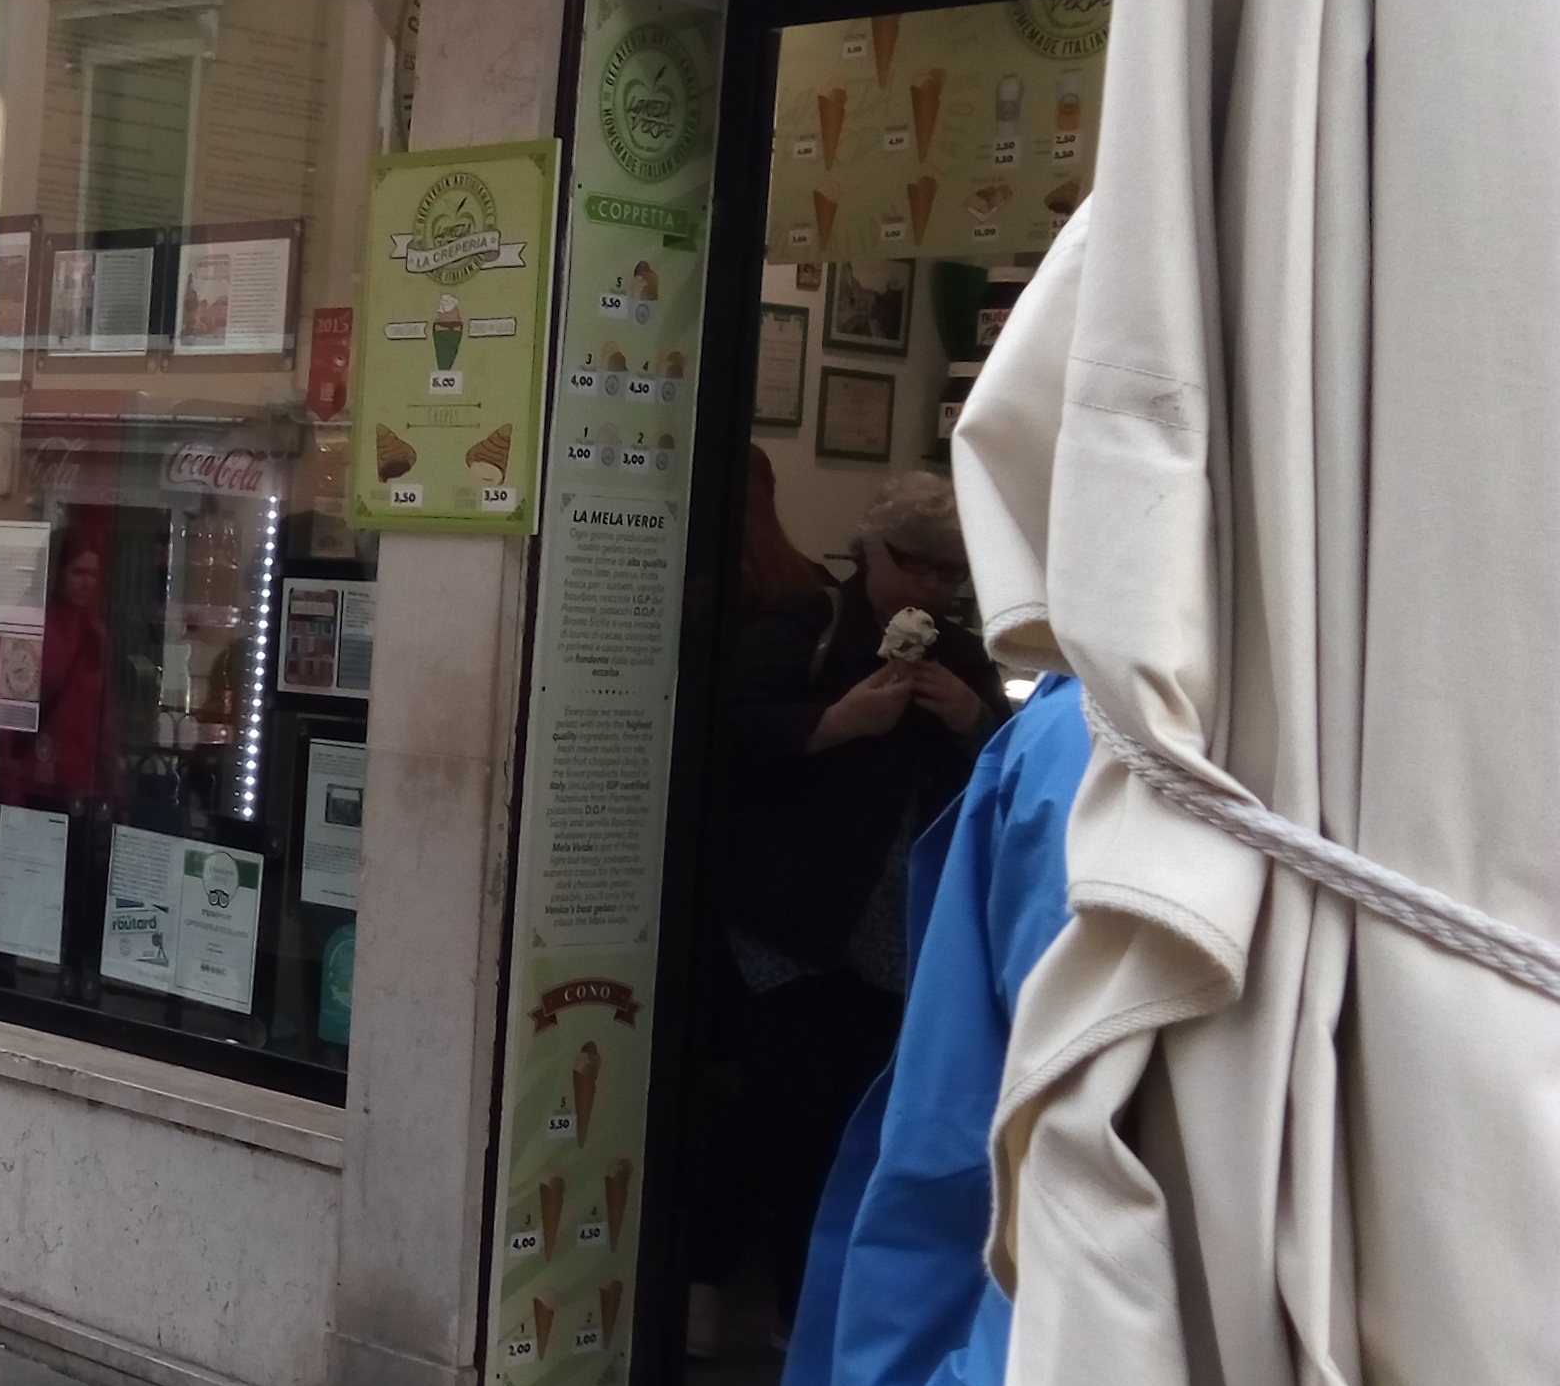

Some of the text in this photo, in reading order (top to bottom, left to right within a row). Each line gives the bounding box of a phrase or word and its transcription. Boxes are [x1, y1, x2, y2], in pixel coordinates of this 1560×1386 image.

[1011, 1, 1060, 55] OMEMADE
[598, 199, 675, 230] COPPETTA
[416, 236, 489, 269] LA CREPERIA
[615, 276, 623, 288] 5
[316, 318, 349, 333] 2015
[573, 510, 665, 529] LA MELA VERDE
[112, 915, 158, 932] routard
[563, 983, 611, 1003] CONO
